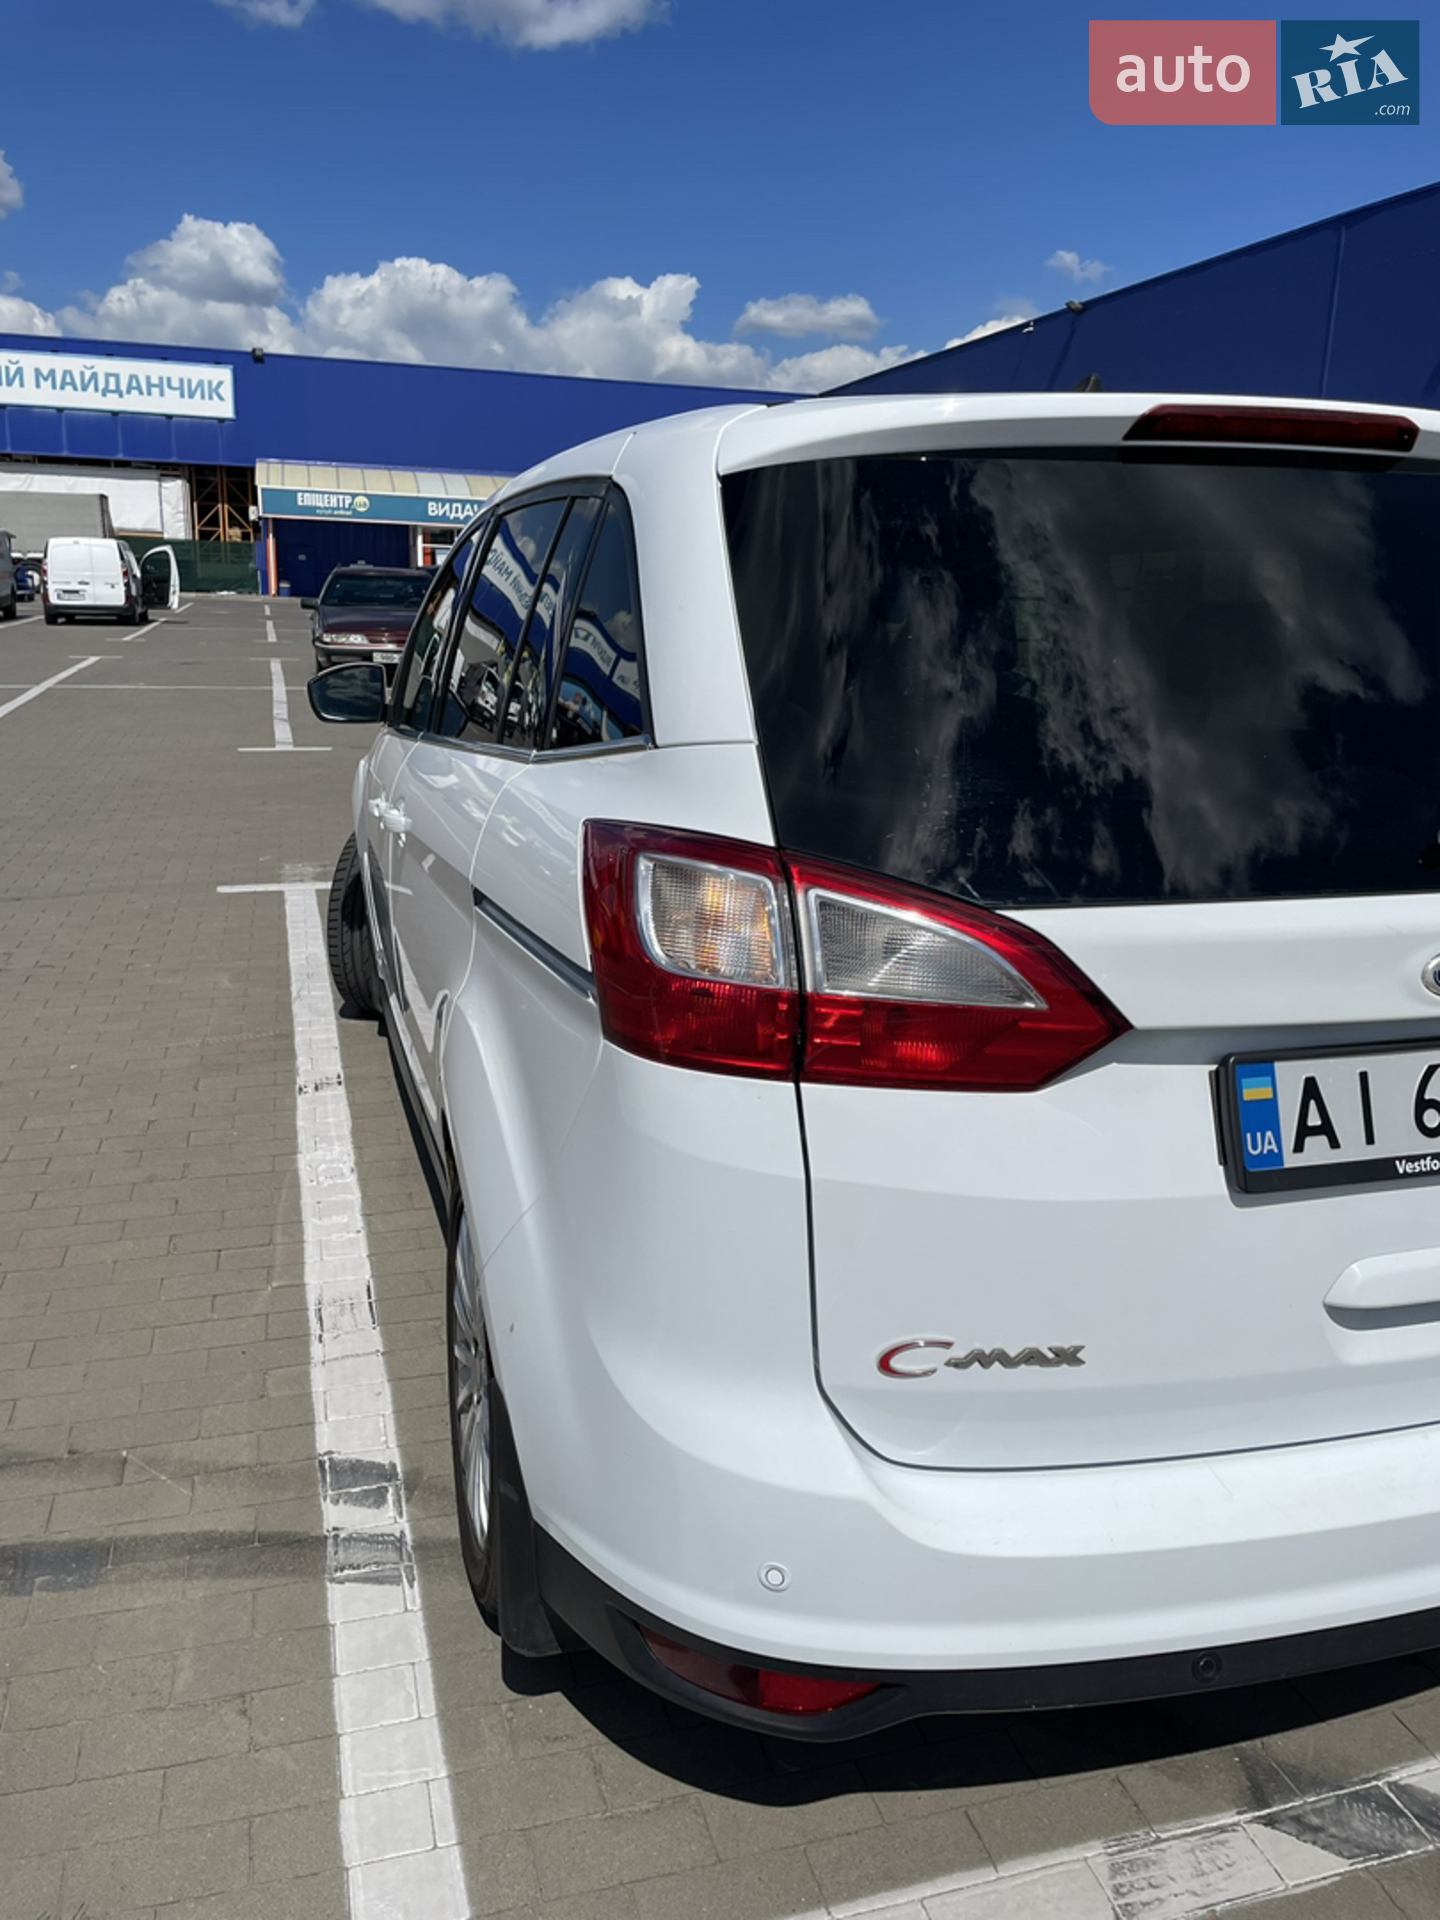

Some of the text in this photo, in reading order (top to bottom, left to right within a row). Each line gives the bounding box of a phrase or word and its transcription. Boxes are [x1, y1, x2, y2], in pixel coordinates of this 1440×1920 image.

[0, 359, 226, 402] Й МАЙДАНЧИК
[1292, 1070, 1376, 1154] AI
[1246, 1130, 1279, 1155] UA
[1395, 1156, 1440, 1174] Vestfo
